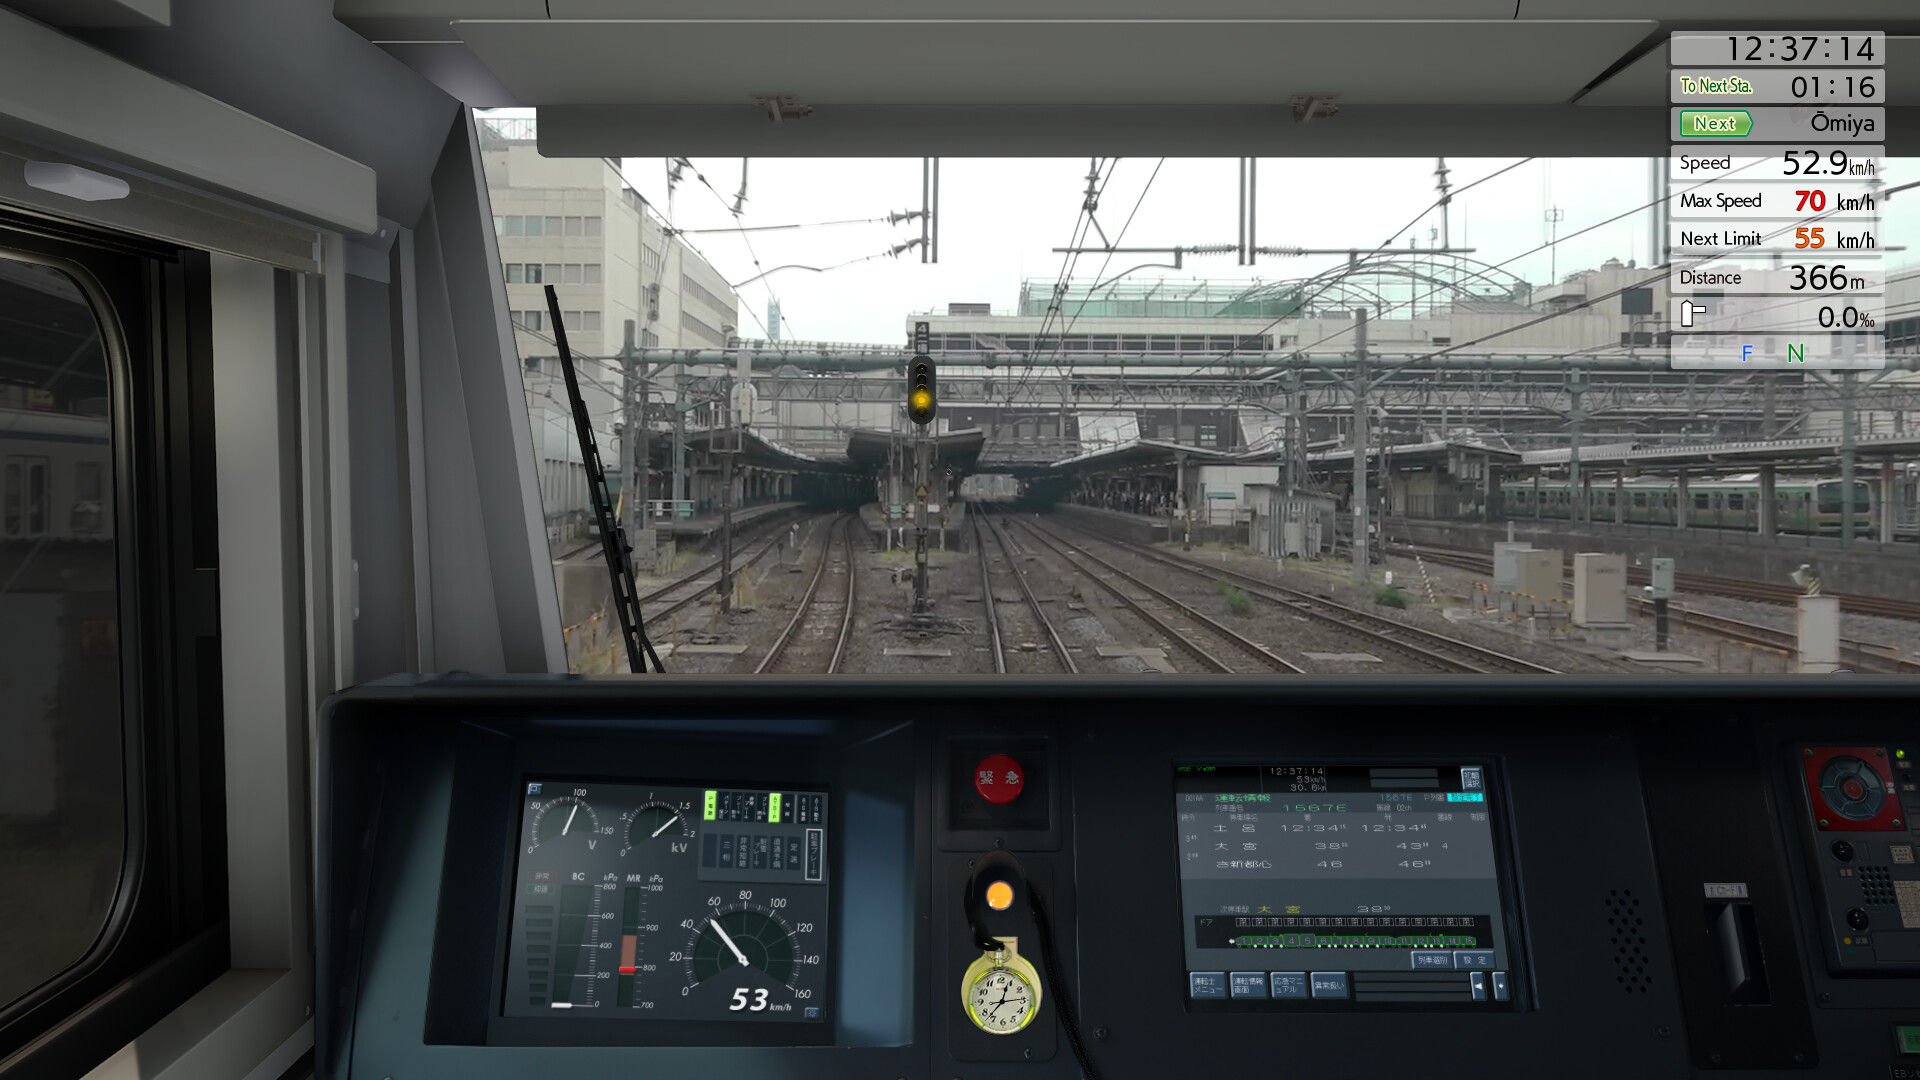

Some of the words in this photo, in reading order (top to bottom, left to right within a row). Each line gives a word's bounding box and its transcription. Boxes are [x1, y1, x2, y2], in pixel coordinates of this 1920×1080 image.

[1271, 767, 1323, 775] 12:37:14
[531, 802, 541, 810] 50
[679, 802, 691, 810] 1.5
[588, 840, 596, 849] V
[671, 843, 688, 853] kV
[620, 849, 626, 857] 0
[572, 872, 585, 881] BC
[604, 873, 618, 882] kPa
[626, 874, 641, 882] MR
[649, 874, 663, 883] kPa
[739, 891, 752, 900] 80
[708, 897, 721, 906] 60
[770, 899, 786, 908] 100
[680, 919, 693, 928] 40
[797, 923, 813, 932] 120
[669, 952, 682, 961] 20
[803, 955, 819, 964] 140
[795, 989, 812, 998] 160
[729, 988, 769, 1011] 53
[770, 1003, 792, 1011] km/h
